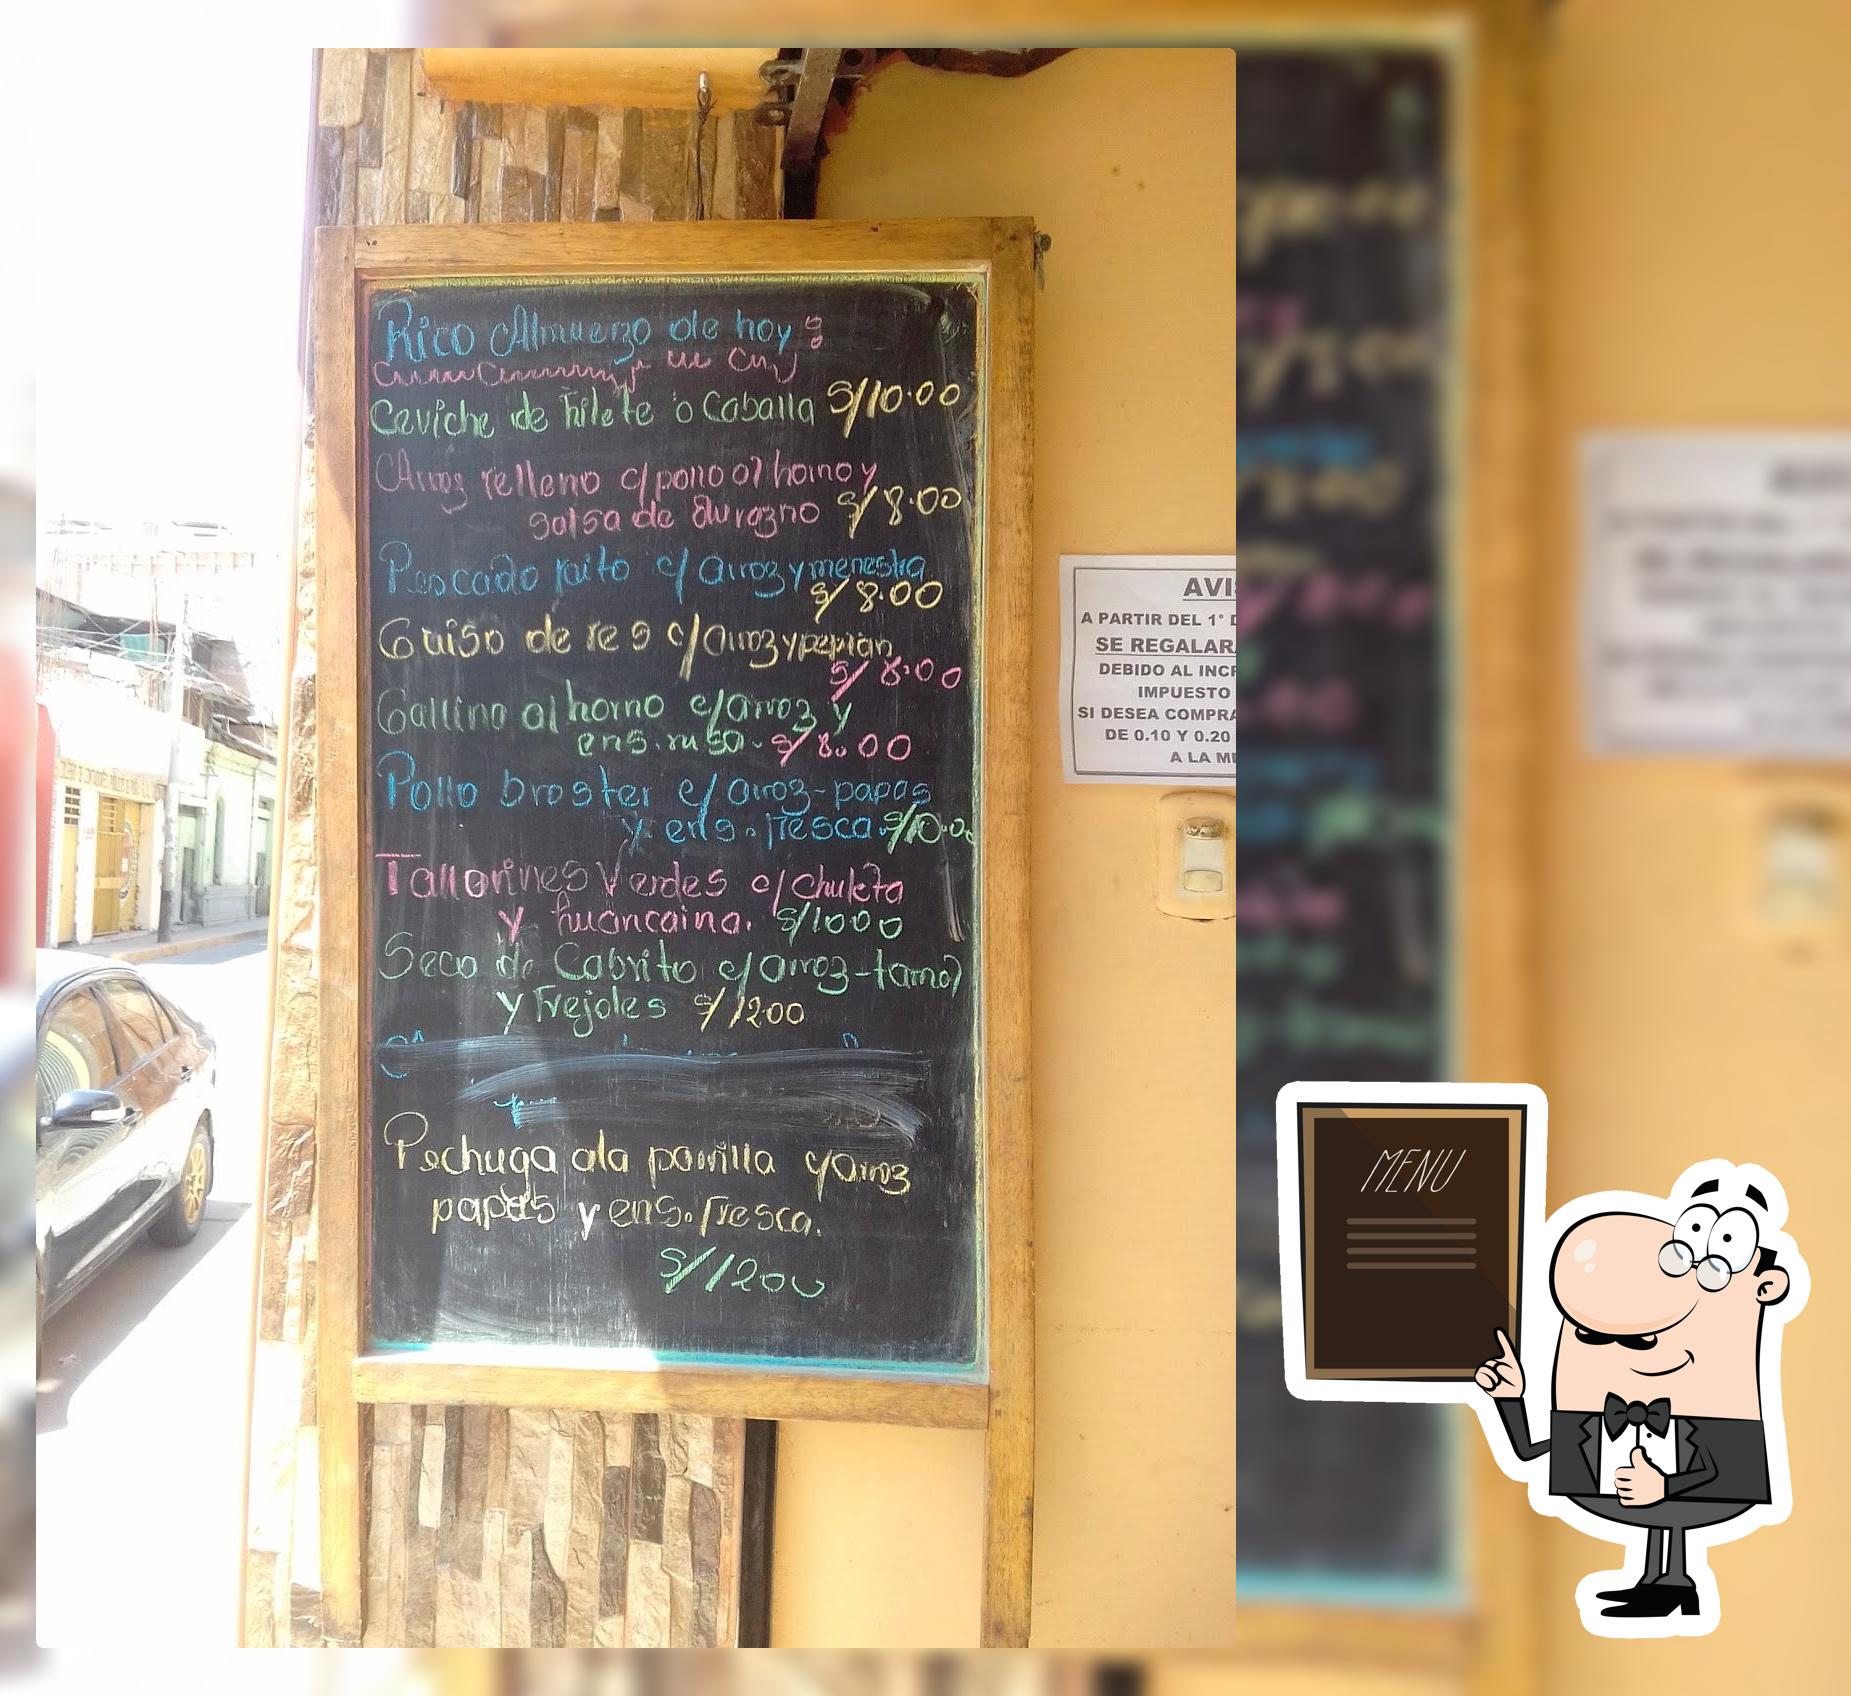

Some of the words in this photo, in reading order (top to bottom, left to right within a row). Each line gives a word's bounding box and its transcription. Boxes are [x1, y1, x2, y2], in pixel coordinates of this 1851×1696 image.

[379, 299, 475, 362] Rico
[490, 304, 652, 364] Almuerzo
[668, 309, 720, 342] de
[736, 309, 792, 355] hoy
[370, 398, 495, 438] Ceviche
[510, 390, 549, 433] de
[702, 390, 815, 426] Caballa
[480, 460, 601, 500] relleno
[732, 455, 763, 488] al
[631, 500, 675, 530] de
[379, 540, 541, 598] Pescado
[1183, 577, 1236, 597] AVI
[378, 616, 506, 660] Guiso
[525, 613, 572, 654] de
[1081, 612, 1092, 624] A
[1098, 612, 1162, 626] PARTIR
[1168, 614, 1202, 626] DEL
[1095, 637, 1123, 652] SE
[1130, 638, 1236, 654] REGALAR
[1099, 663, 1165, 677] DEBIDO
[1170, 665, 1193, 677] AL
[1138, 686, 1231, 699] IMPUESTO
[520, 694, 560, 734] al
[564, 678, 666, 722] horno
[831, 701, 853, 736] y
[1078, 707, 1094, 719] SI
[1101, 707, 1159, 720] DESEA
[1105, 729, 1129, 741] DE
[1134, 729, 1170, 742] 0.10
[1176, 730, 1188, 742] Y
[1194, 731, 1231, 743] 0.20
[1170, 751, 1182, 763] A
[1187, 752, 1211, 764] LA
[376, 750, 479, 811] Pollo
[499, 763, 652, 810] broster
[374, 851, 590, 900] Tallarines
[497, 906, 525, 944] y
[379, 931, 479, 980] Seco
[552, 938, 699, 984] Cabrito
[495, 990, 525, 1036] y
[383, 1111, 559, 1200] Pechuga
[648, 1139, 777, 1191] parrilla
[431, 1182, 556, 1236] papas
[577, 1200, 600, 1242] y
